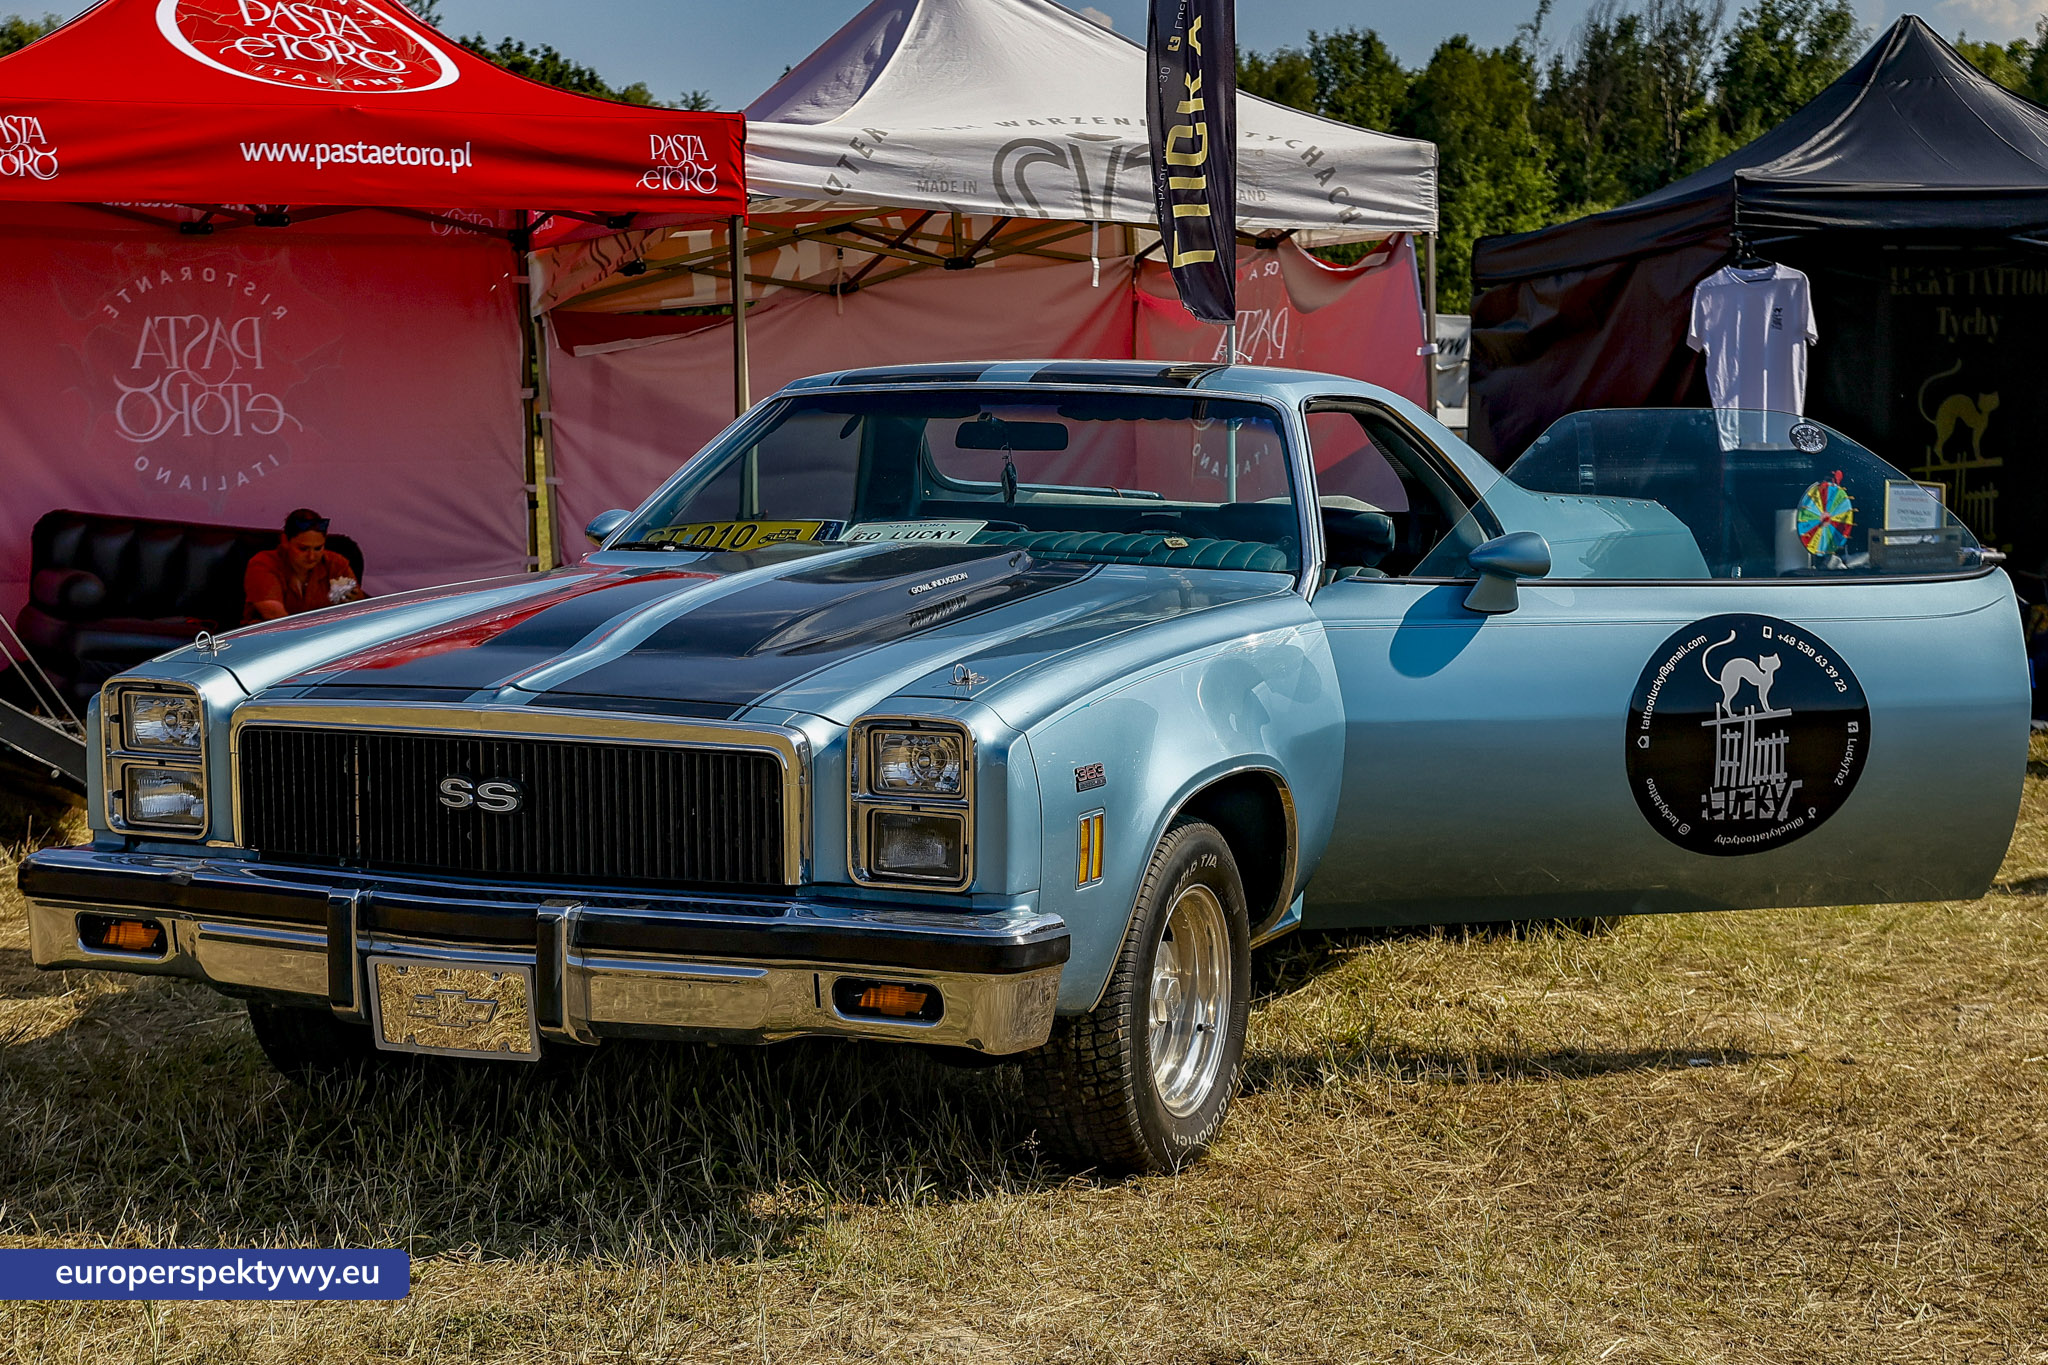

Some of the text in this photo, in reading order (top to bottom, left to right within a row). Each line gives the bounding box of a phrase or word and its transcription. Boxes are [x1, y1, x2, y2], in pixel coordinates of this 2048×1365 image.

[237, 0, 377, 44] PASTA
[254, 64, 404, 86] ITALIANO
[240, 141, 473, 174] www.pastaetoro.pl
[649, 133, 709, 165] PASTA
[917, 180, 1266, 201] MADE IN AND
[1936, 305, 2000, 344] Tychy
[889, 530, 963, 540] LUCKY
[1777, 634, 1848, 693] +48 530 63 39 23
[1640, 634, 1708, 730] tattoolucky@gmail.com
[1834, 738, 1858, 787] LuckyTa2
[439, 776, 519, 812] SS
[1646, 778, 1680, 828] lucky.tattoo
[1714, 816, 1805, 846] @luckytattootychy
[1200, 853, 1218, 869] T/A
